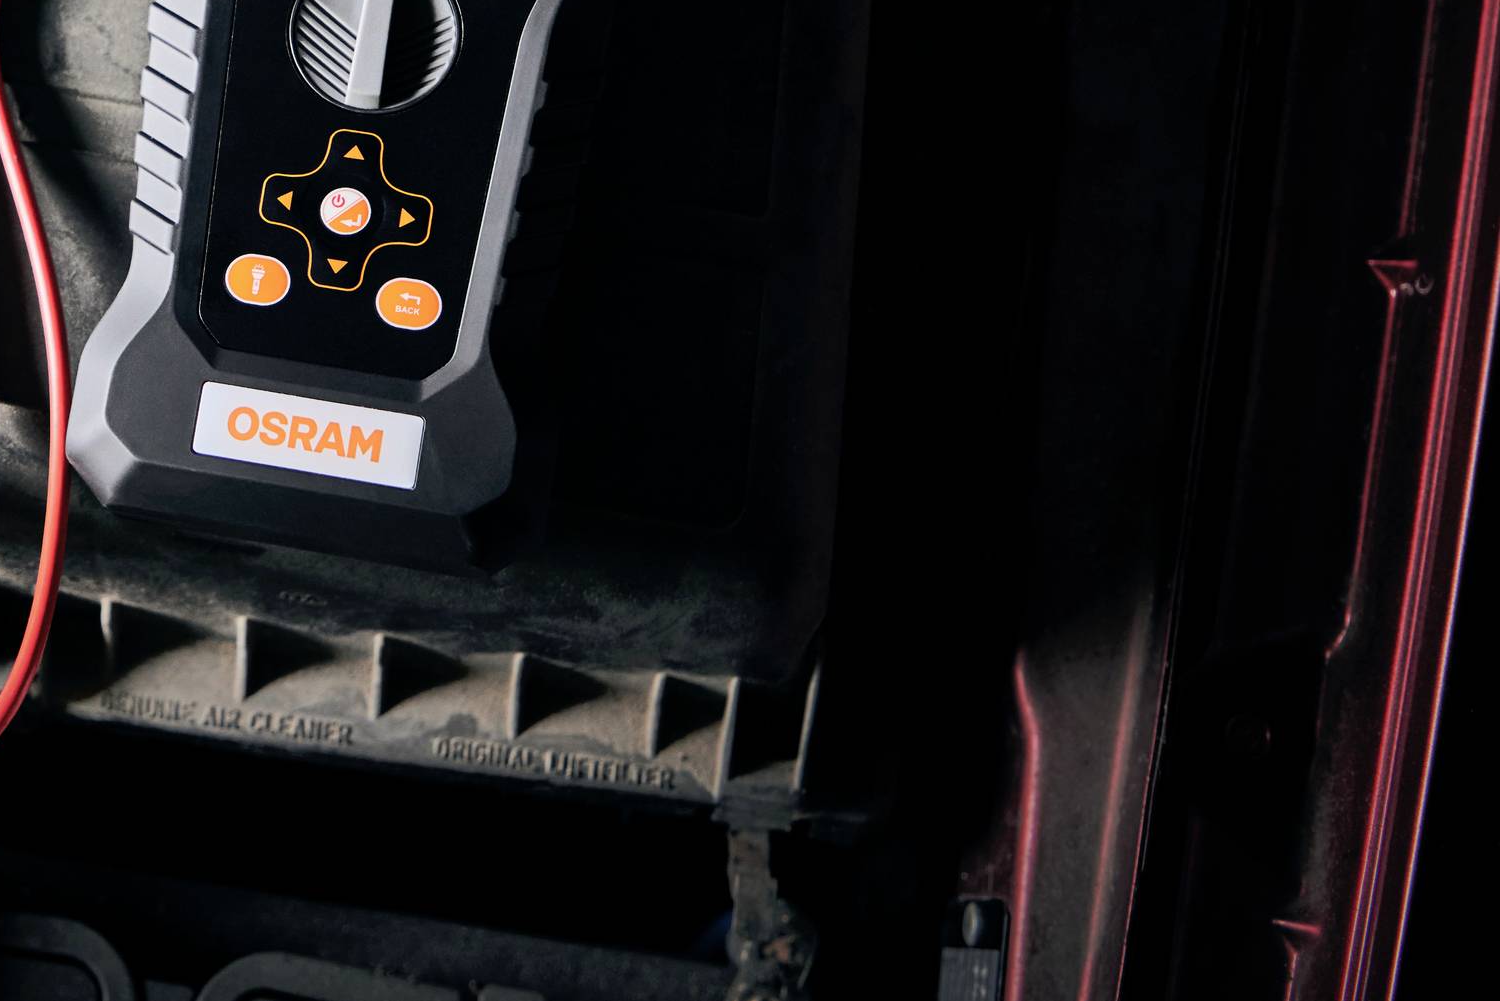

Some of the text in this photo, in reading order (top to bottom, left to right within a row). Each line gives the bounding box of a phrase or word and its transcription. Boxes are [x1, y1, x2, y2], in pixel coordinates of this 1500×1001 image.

[394, 304, 421, 316] BACK
[227, 406, 384, 463] OSRAM
[200, 704, 244, 732] AIR
[249, 711, 354, 747] CLEANER
[431, 735, 541, 774] ORIGINAL
